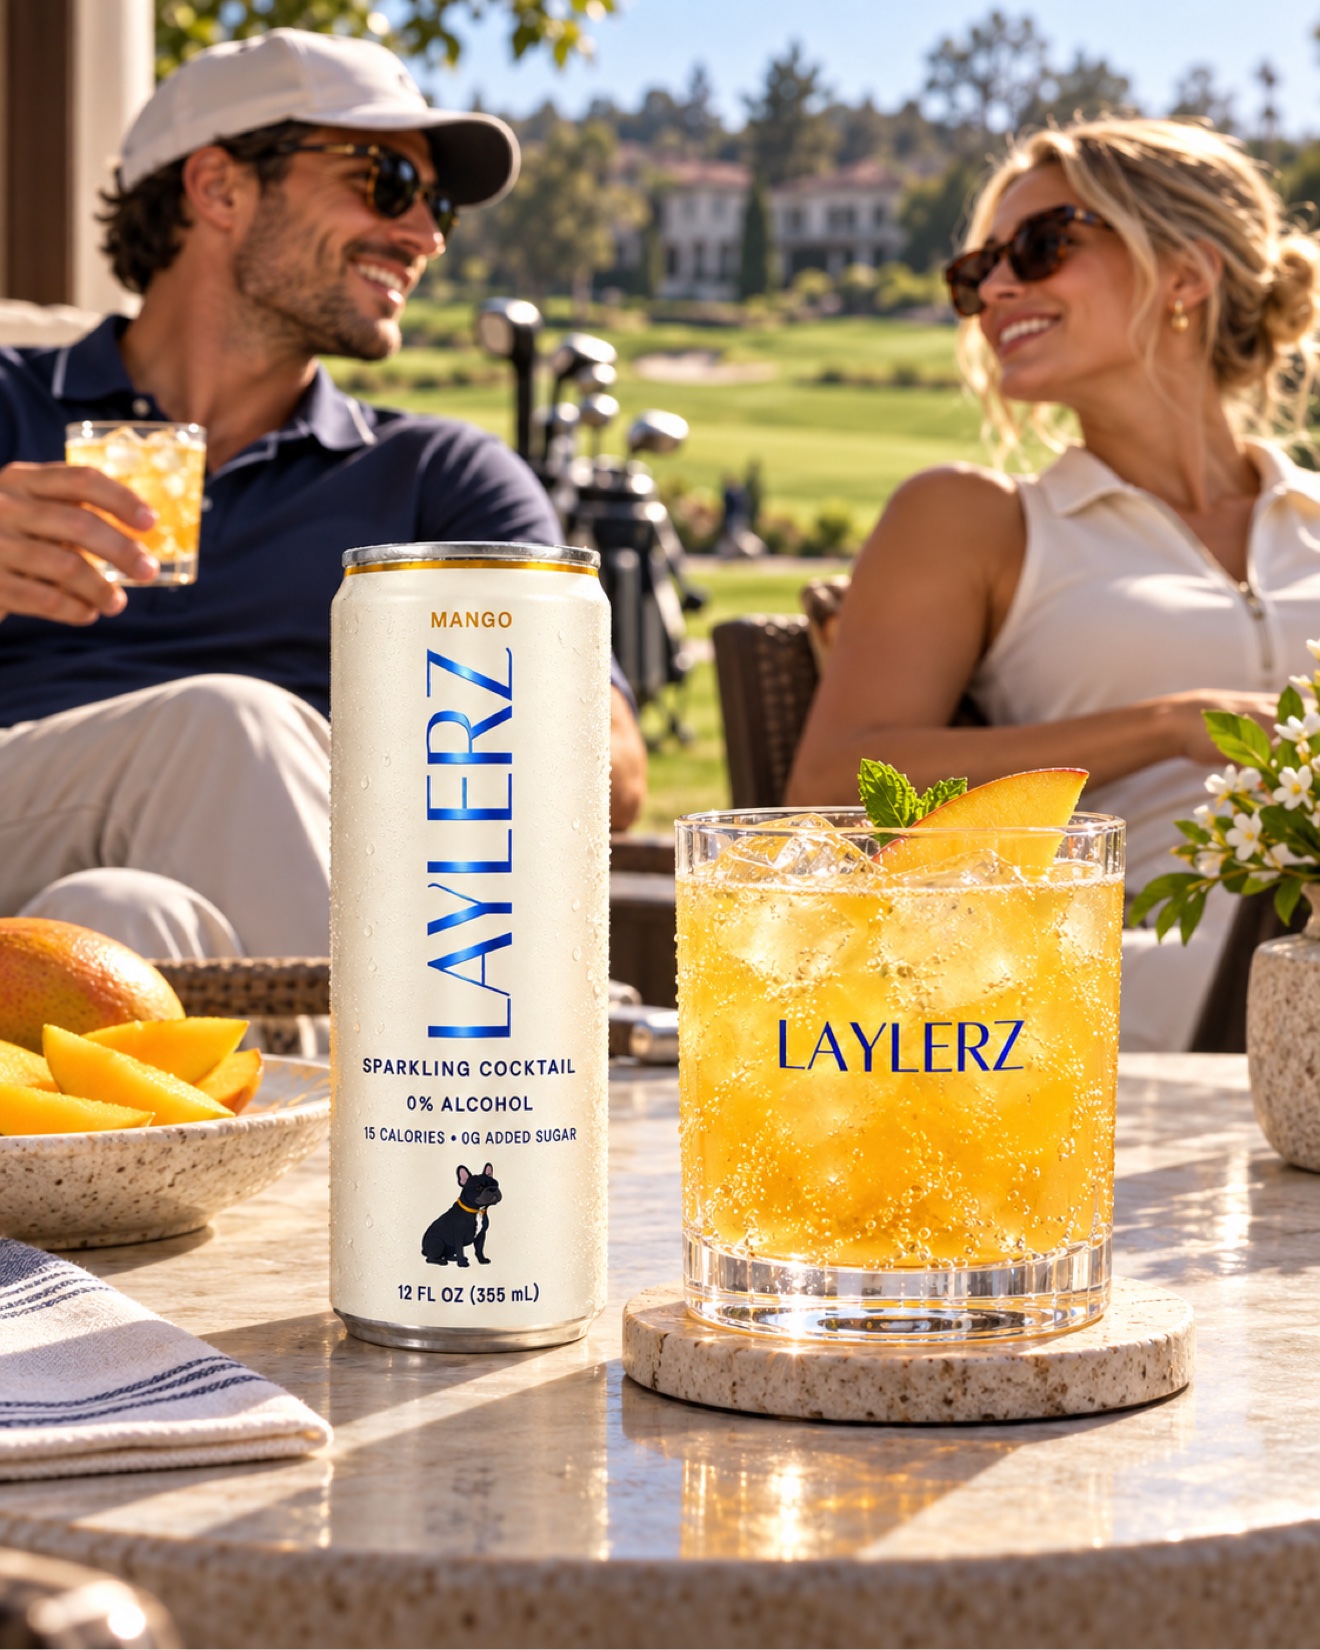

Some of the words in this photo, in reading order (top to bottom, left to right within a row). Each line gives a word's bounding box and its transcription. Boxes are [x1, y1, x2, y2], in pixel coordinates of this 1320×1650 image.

[430, 611, 513, 628] MANGO
[427, 647, 513, 1039] LAYLERZ
[779, 1019, 1025, 1073] LAYLERZ
[362, 1058, 470, 1077] SPARKLING
[479, 1058, 576, 1077] COCKTAIL
[406, 1095, 434, 1112] 0%
[441, 1096, 533, 1112] ALCOHOL
[363, 1126, 376, 1140] 15
[379, 1127, 445, 1145] CALORIES
[461, 1132, 481, 1145] 0G
[485, 1131, 531, 1145] ADDED
[535, 1127, 577, 1142] SUGAR
[398, 1284, 412, 1300] 12
[417, 1286, 436, 1302] FL
[441, 1287, 464, 1303] OZ
[469, 1285, 506, 1305] (355
[511, 1282, 540, 1303] mL)
